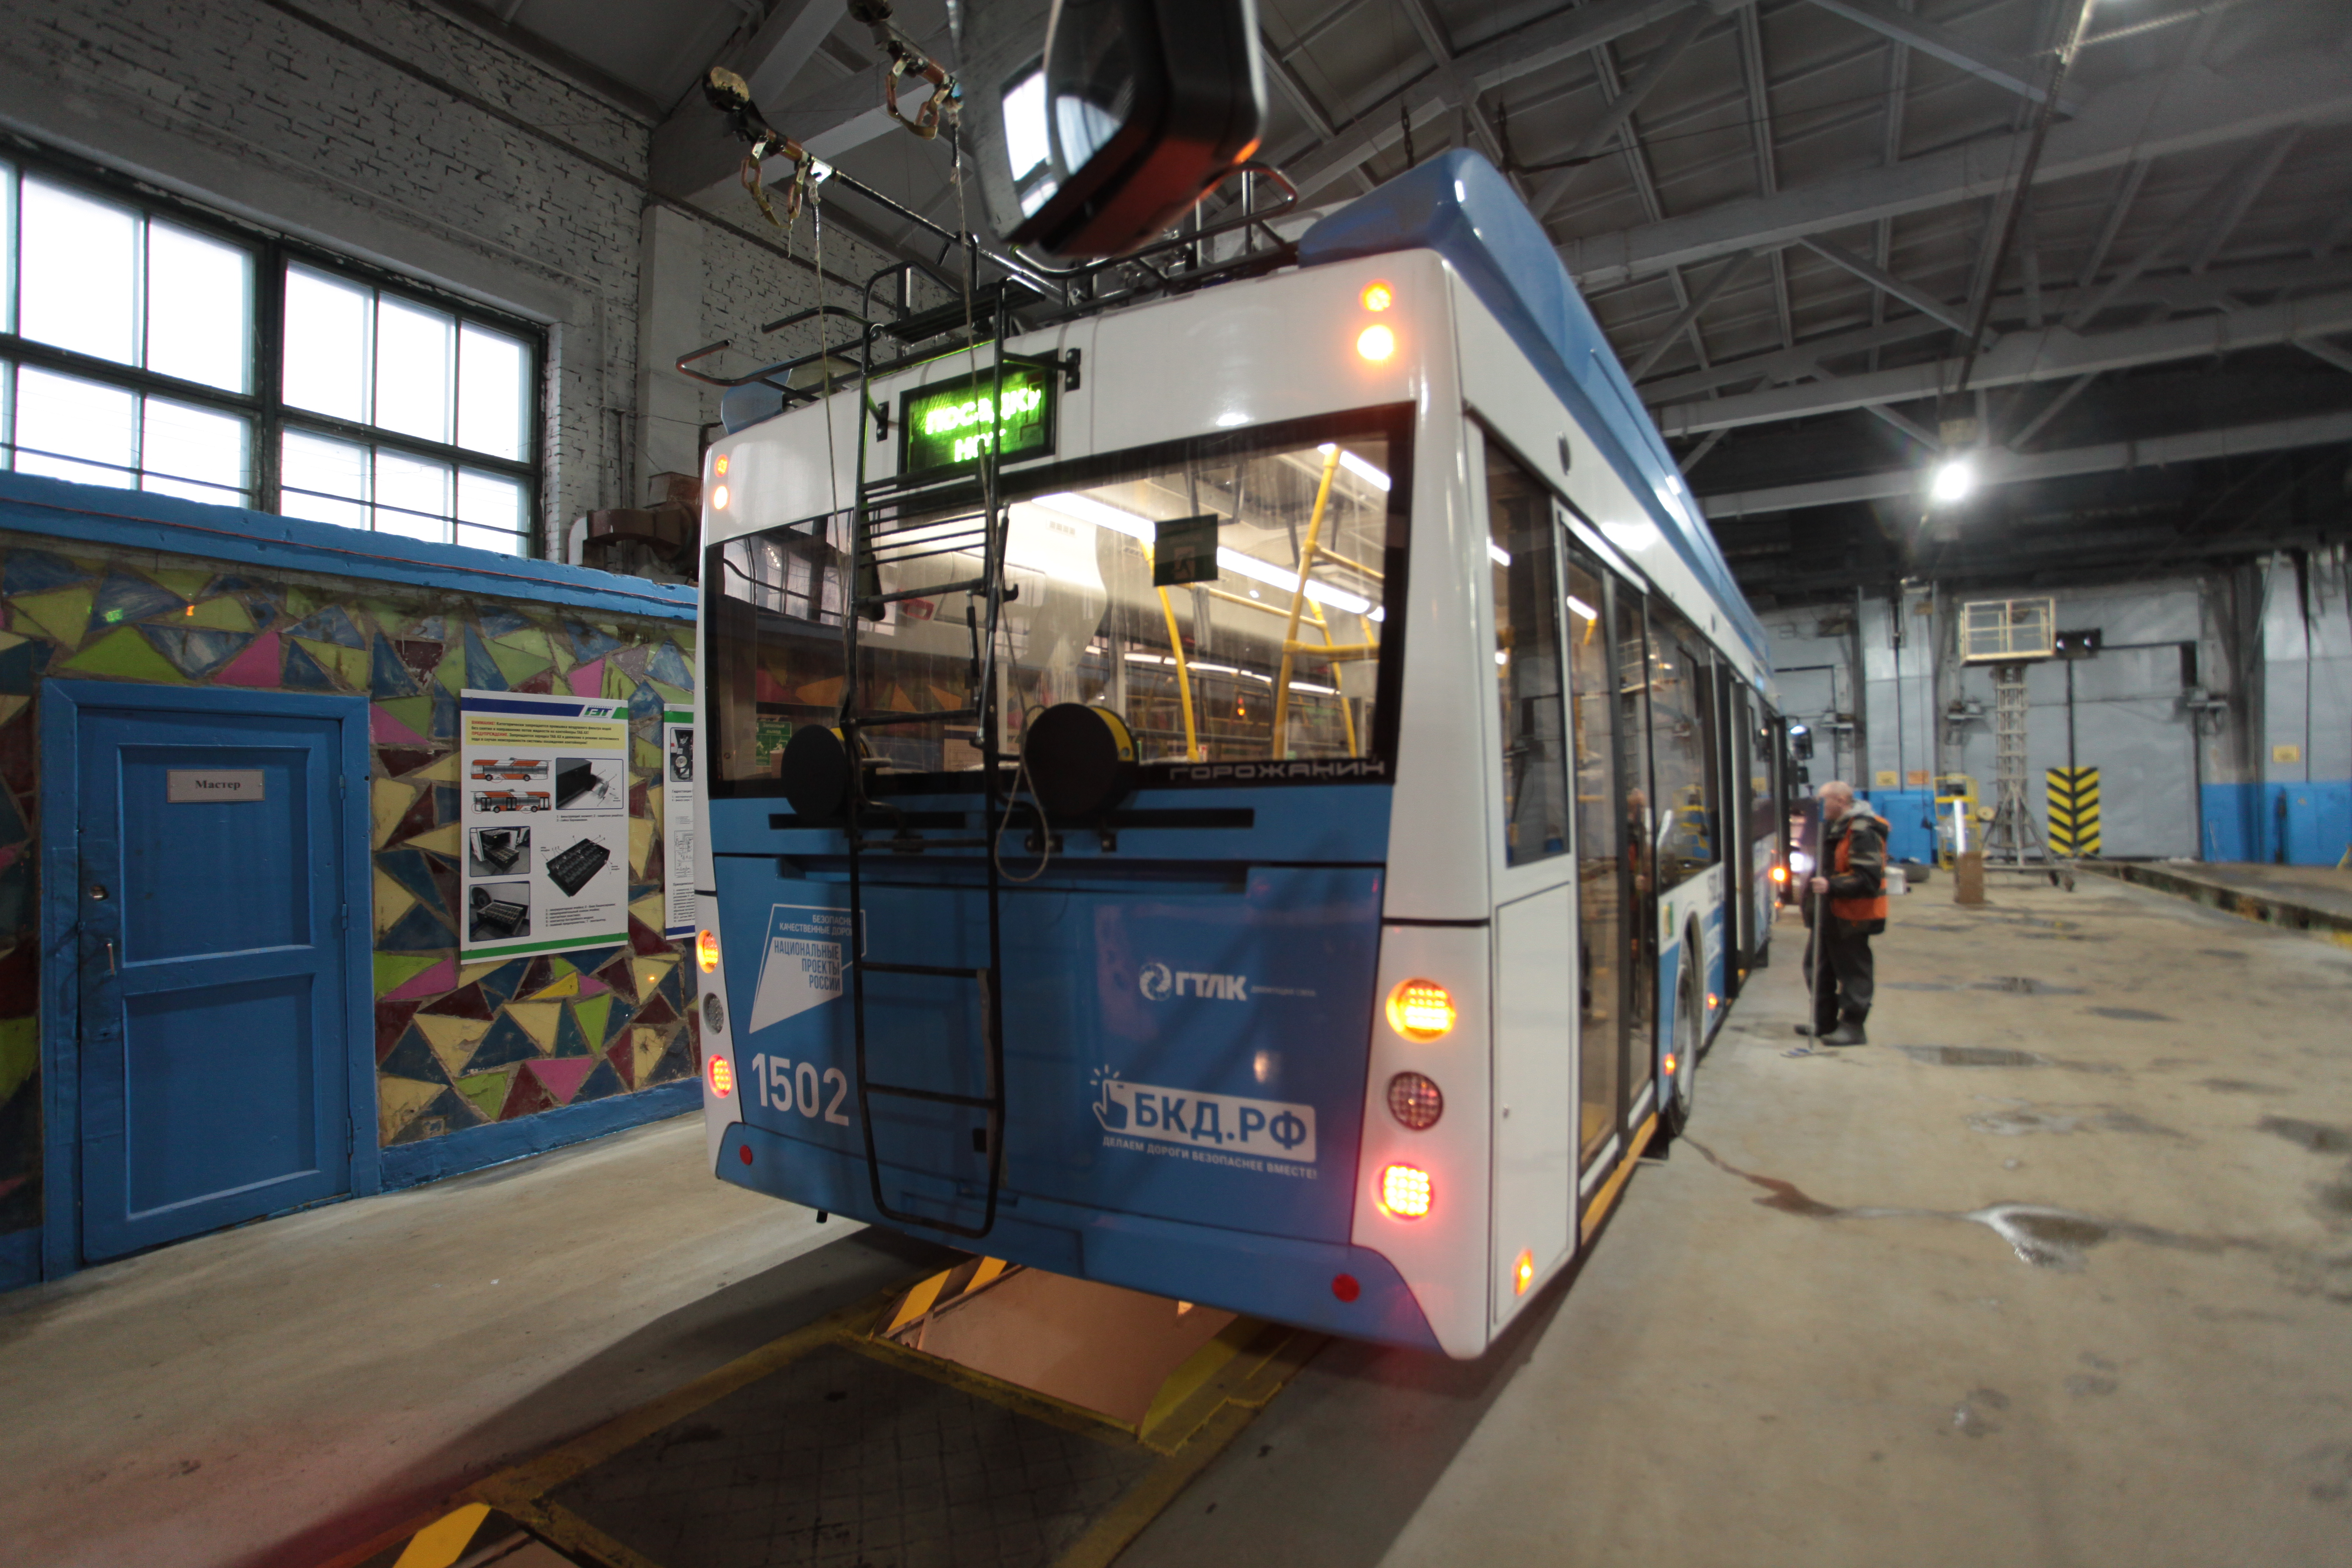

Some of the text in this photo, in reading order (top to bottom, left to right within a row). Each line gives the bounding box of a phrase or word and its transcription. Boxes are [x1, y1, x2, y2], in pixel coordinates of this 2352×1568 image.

[1170, 761, 1385, 780] ГОРОЖАНИН
[195, 780, 241, 790] Мастер
[779, 922, 852, 936] КАЧЕСТВЕННЫЕ ДОРО
[812, 915, 852, 926] БЕЗОПАСН
[774, 940, 839, 960] НАЦИОНАЛЬНЫЕ
[802, 958, 840, 976] ПРОЕКТЫ
[809, 975, 841, 992] РОССИИ
[1175, 971, 1248, 1001] ГТЛК
[752, 1053, 849, 1126] 1502
[1135, 1092, 1307, 1150] БКД.РФ
[1103, 1136, 1144, 1151] ДЕЛАЕМ
[1147, 1144, 1190, 1159] ДОРОГИ
[1191, 1150, 1264, 1172] БЕЗОПАСНЕЕ
